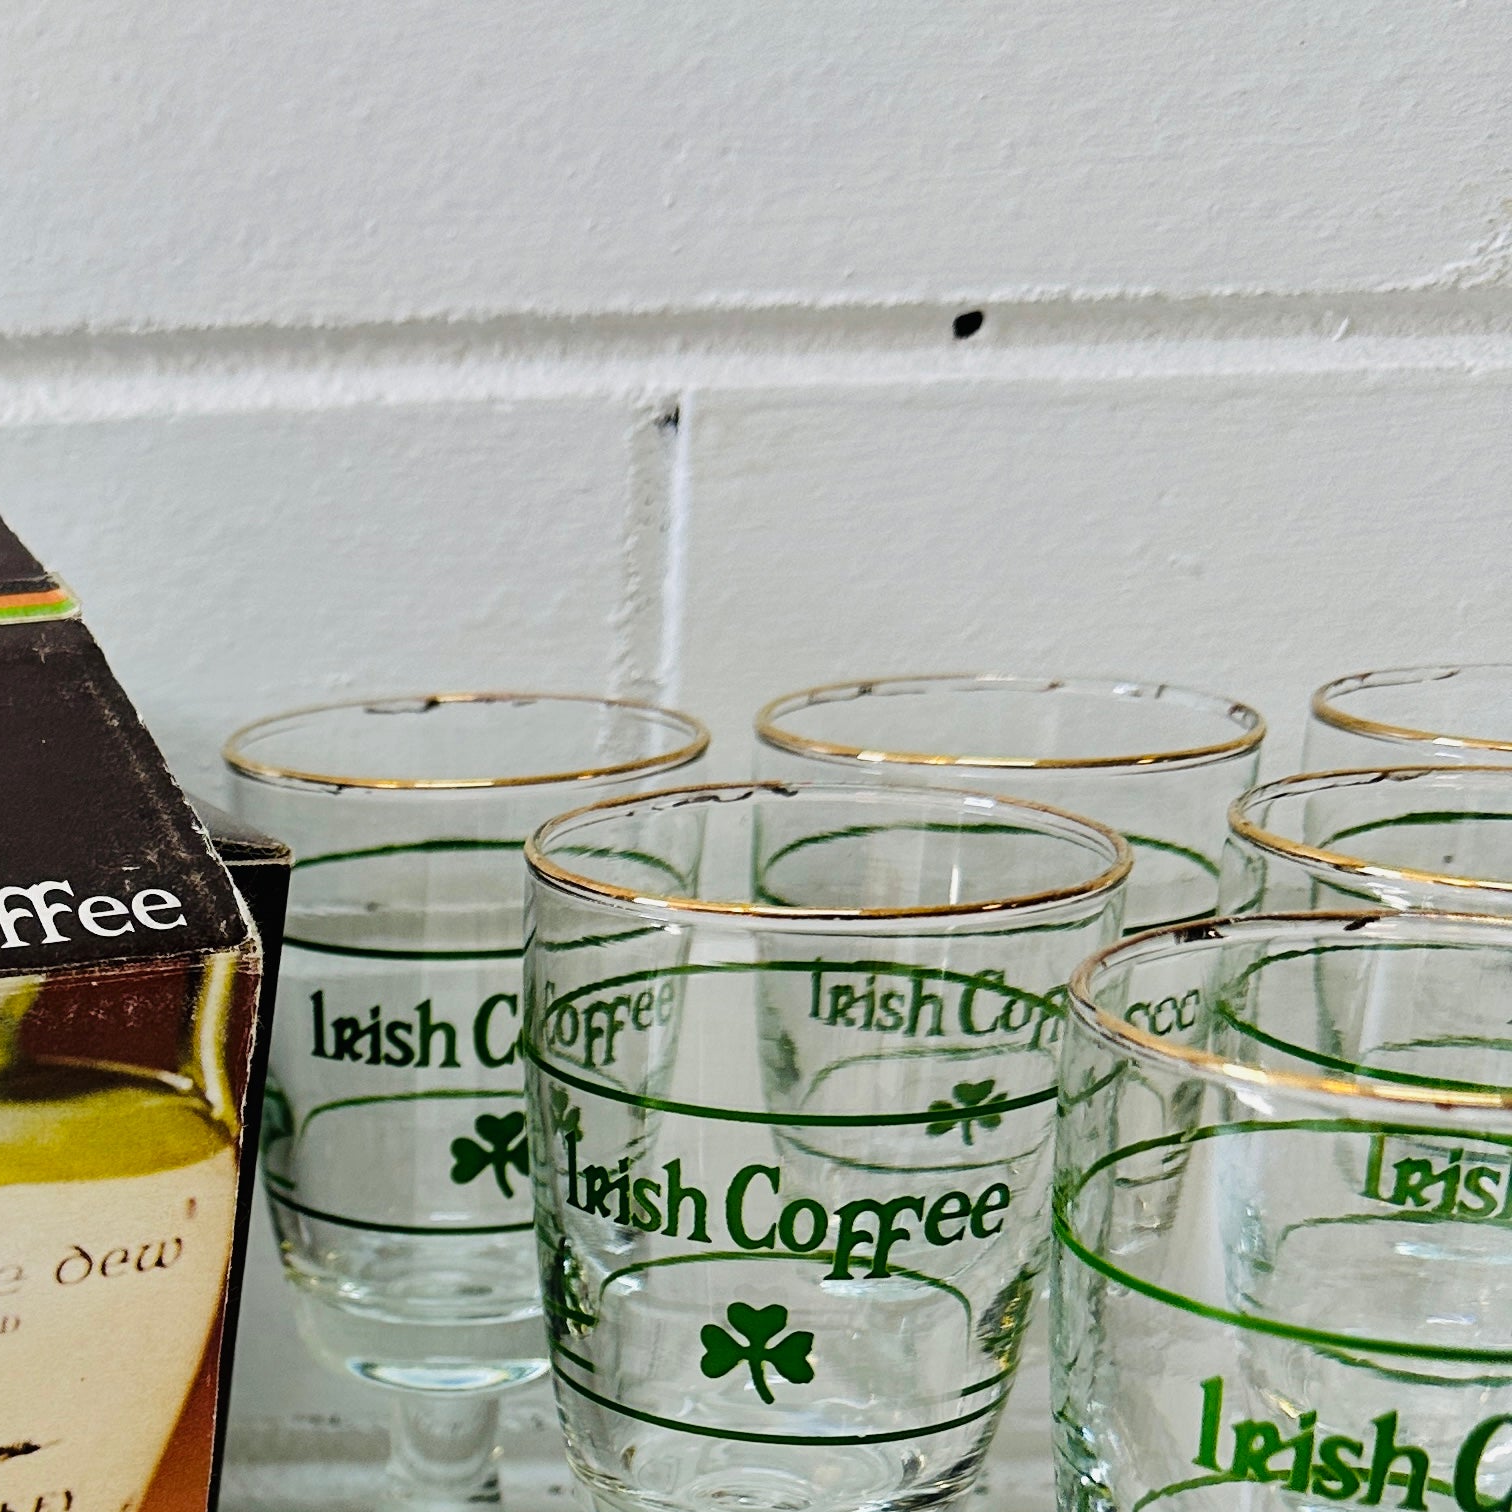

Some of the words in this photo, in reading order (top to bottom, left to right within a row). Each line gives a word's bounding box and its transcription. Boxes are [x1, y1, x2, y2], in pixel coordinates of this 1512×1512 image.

[308, 989, 461, 1069] Irish
[564, 1130, 713, 1244] Irish
[725, 1163, 1011, 1281] Coffee
[1191, 1374, 1430, 1512] Irish
